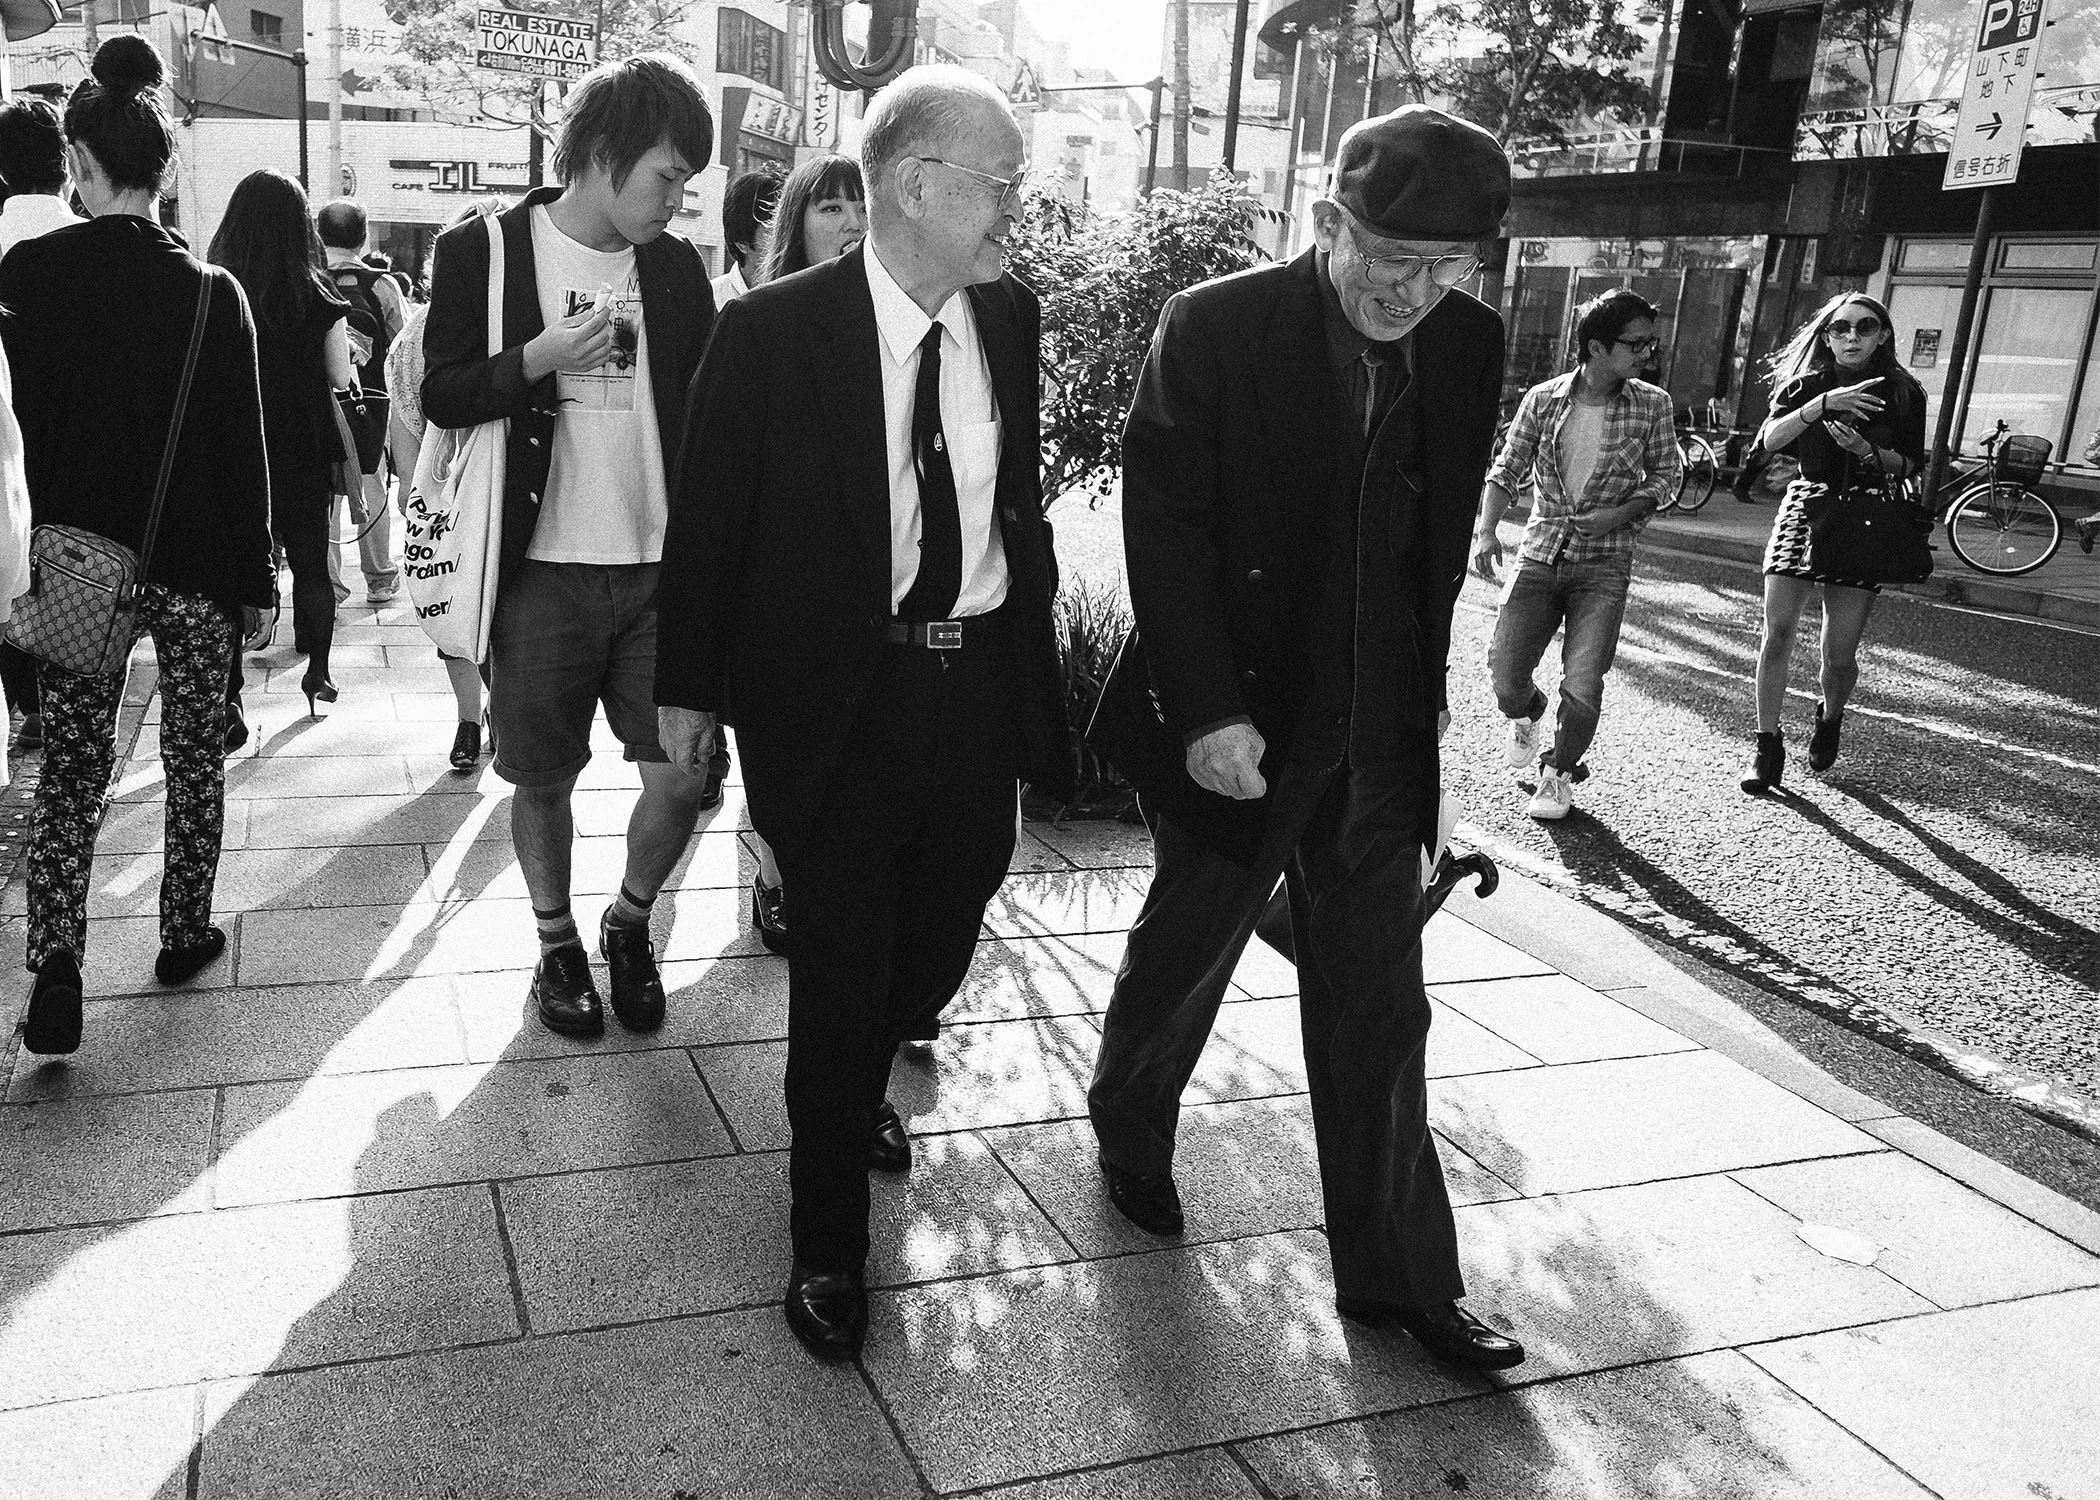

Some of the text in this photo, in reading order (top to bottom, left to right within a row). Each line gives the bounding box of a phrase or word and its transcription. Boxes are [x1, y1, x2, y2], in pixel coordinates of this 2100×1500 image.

[2018, 0, 2039, 15] 24H
[480, 10, 591, 39] REAL ESTATE
[1982, 0, 2013, 46] P
[480, 28, 588, 61] TOKUNAGA
[1976, 47, 2030, 77] 山下町
[1979, 73, 2017, 99] 地下
[1953, 153, 2013, 179] 信号右折
[392, 183, 424, 191] CAFE
